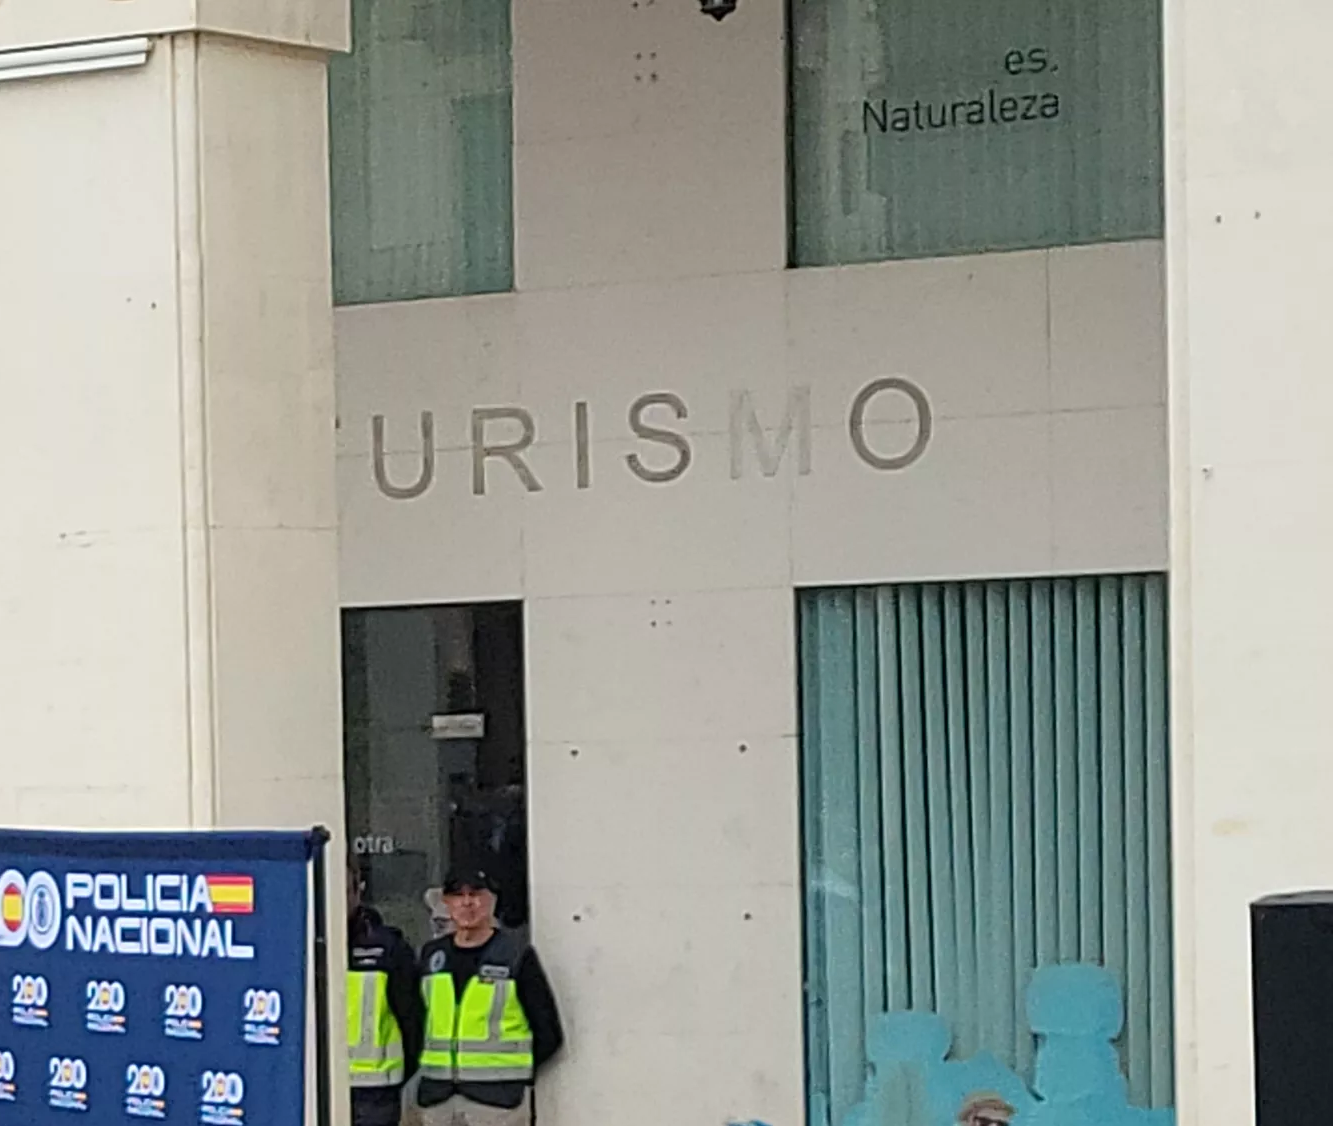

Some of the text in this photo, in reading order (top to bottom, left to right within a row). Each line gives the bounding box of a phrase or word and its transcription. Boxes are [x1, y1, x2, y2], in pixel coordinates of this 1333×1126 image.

[1003, 44, 1059, 77] es.
[861, 89, 1061, 136] Naturaleza
[335, 376, 933, 501] URISMO
[353, 834, 395, 854] otra
[65, 872, 215, 913] POLICIA
[65, 915, 255, 959] NACIONAL
